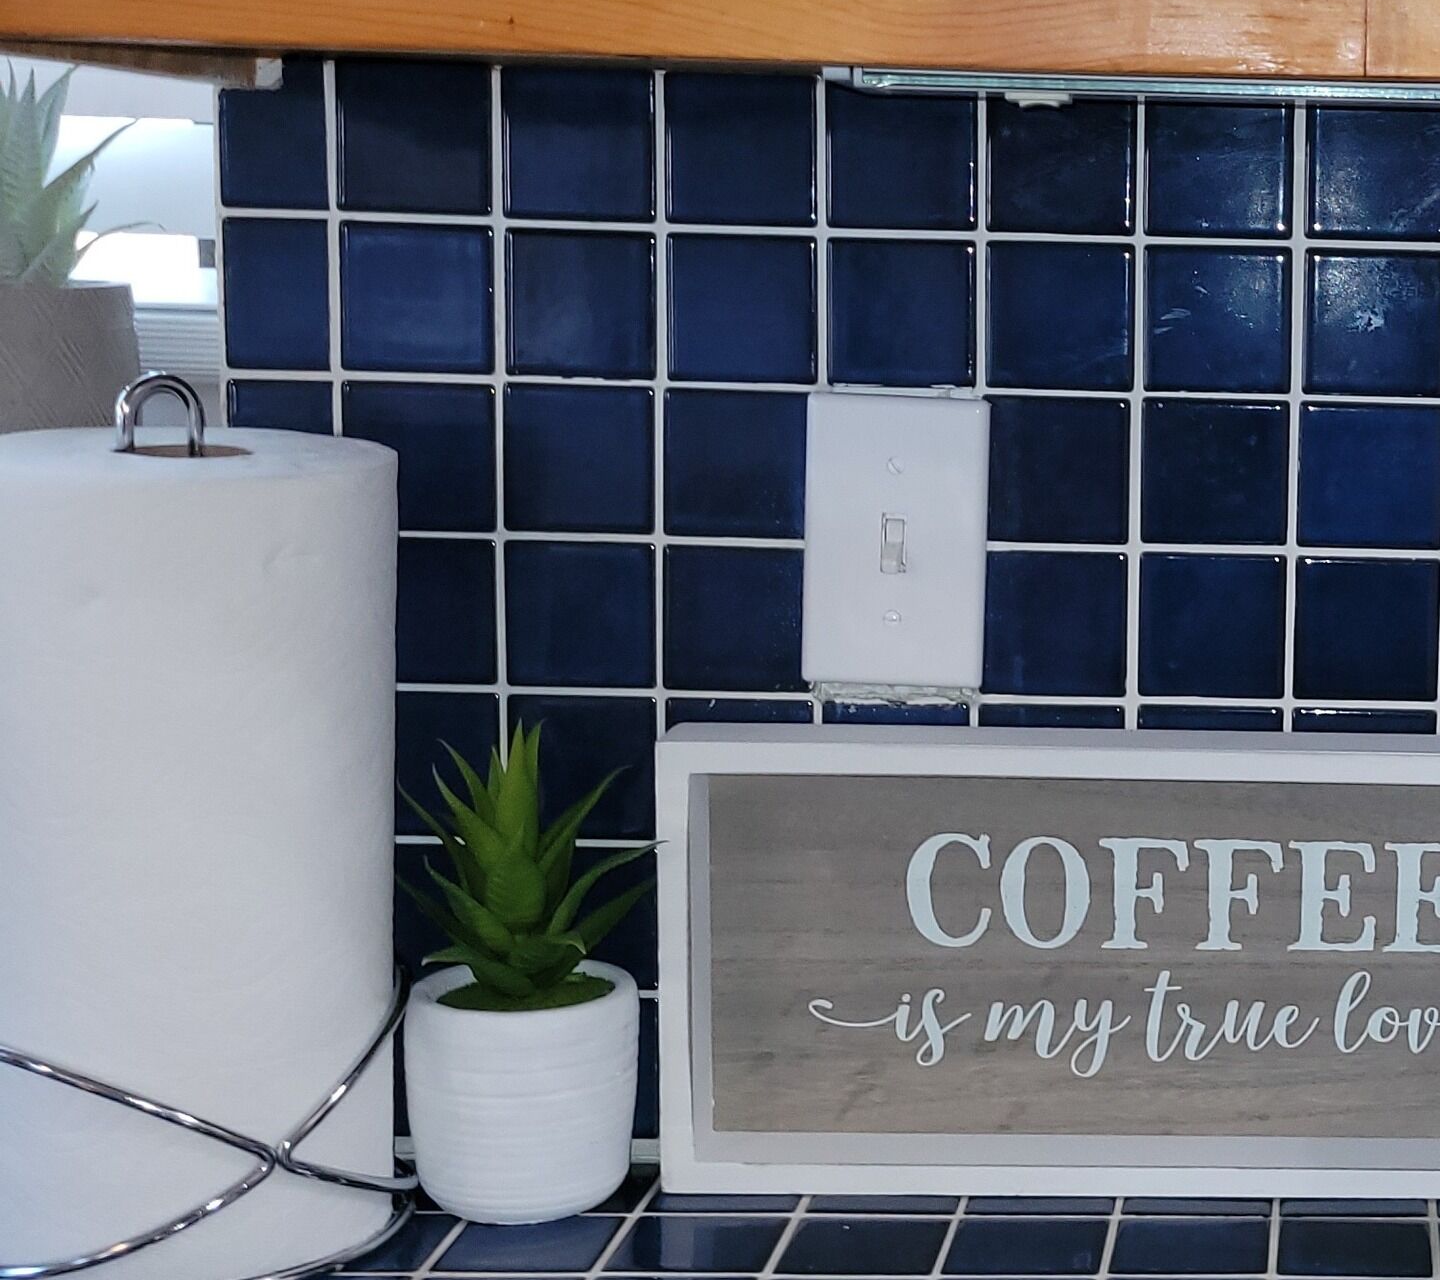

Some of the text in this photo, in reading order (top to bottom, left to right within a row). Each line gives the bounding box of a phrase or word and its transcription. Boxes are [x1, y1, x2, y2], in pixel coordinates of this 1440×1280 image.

[809, 988, 971, 1066] is
[984, 1000, 1132, 1078] my
[1143, 969, 1321, 1063] true
